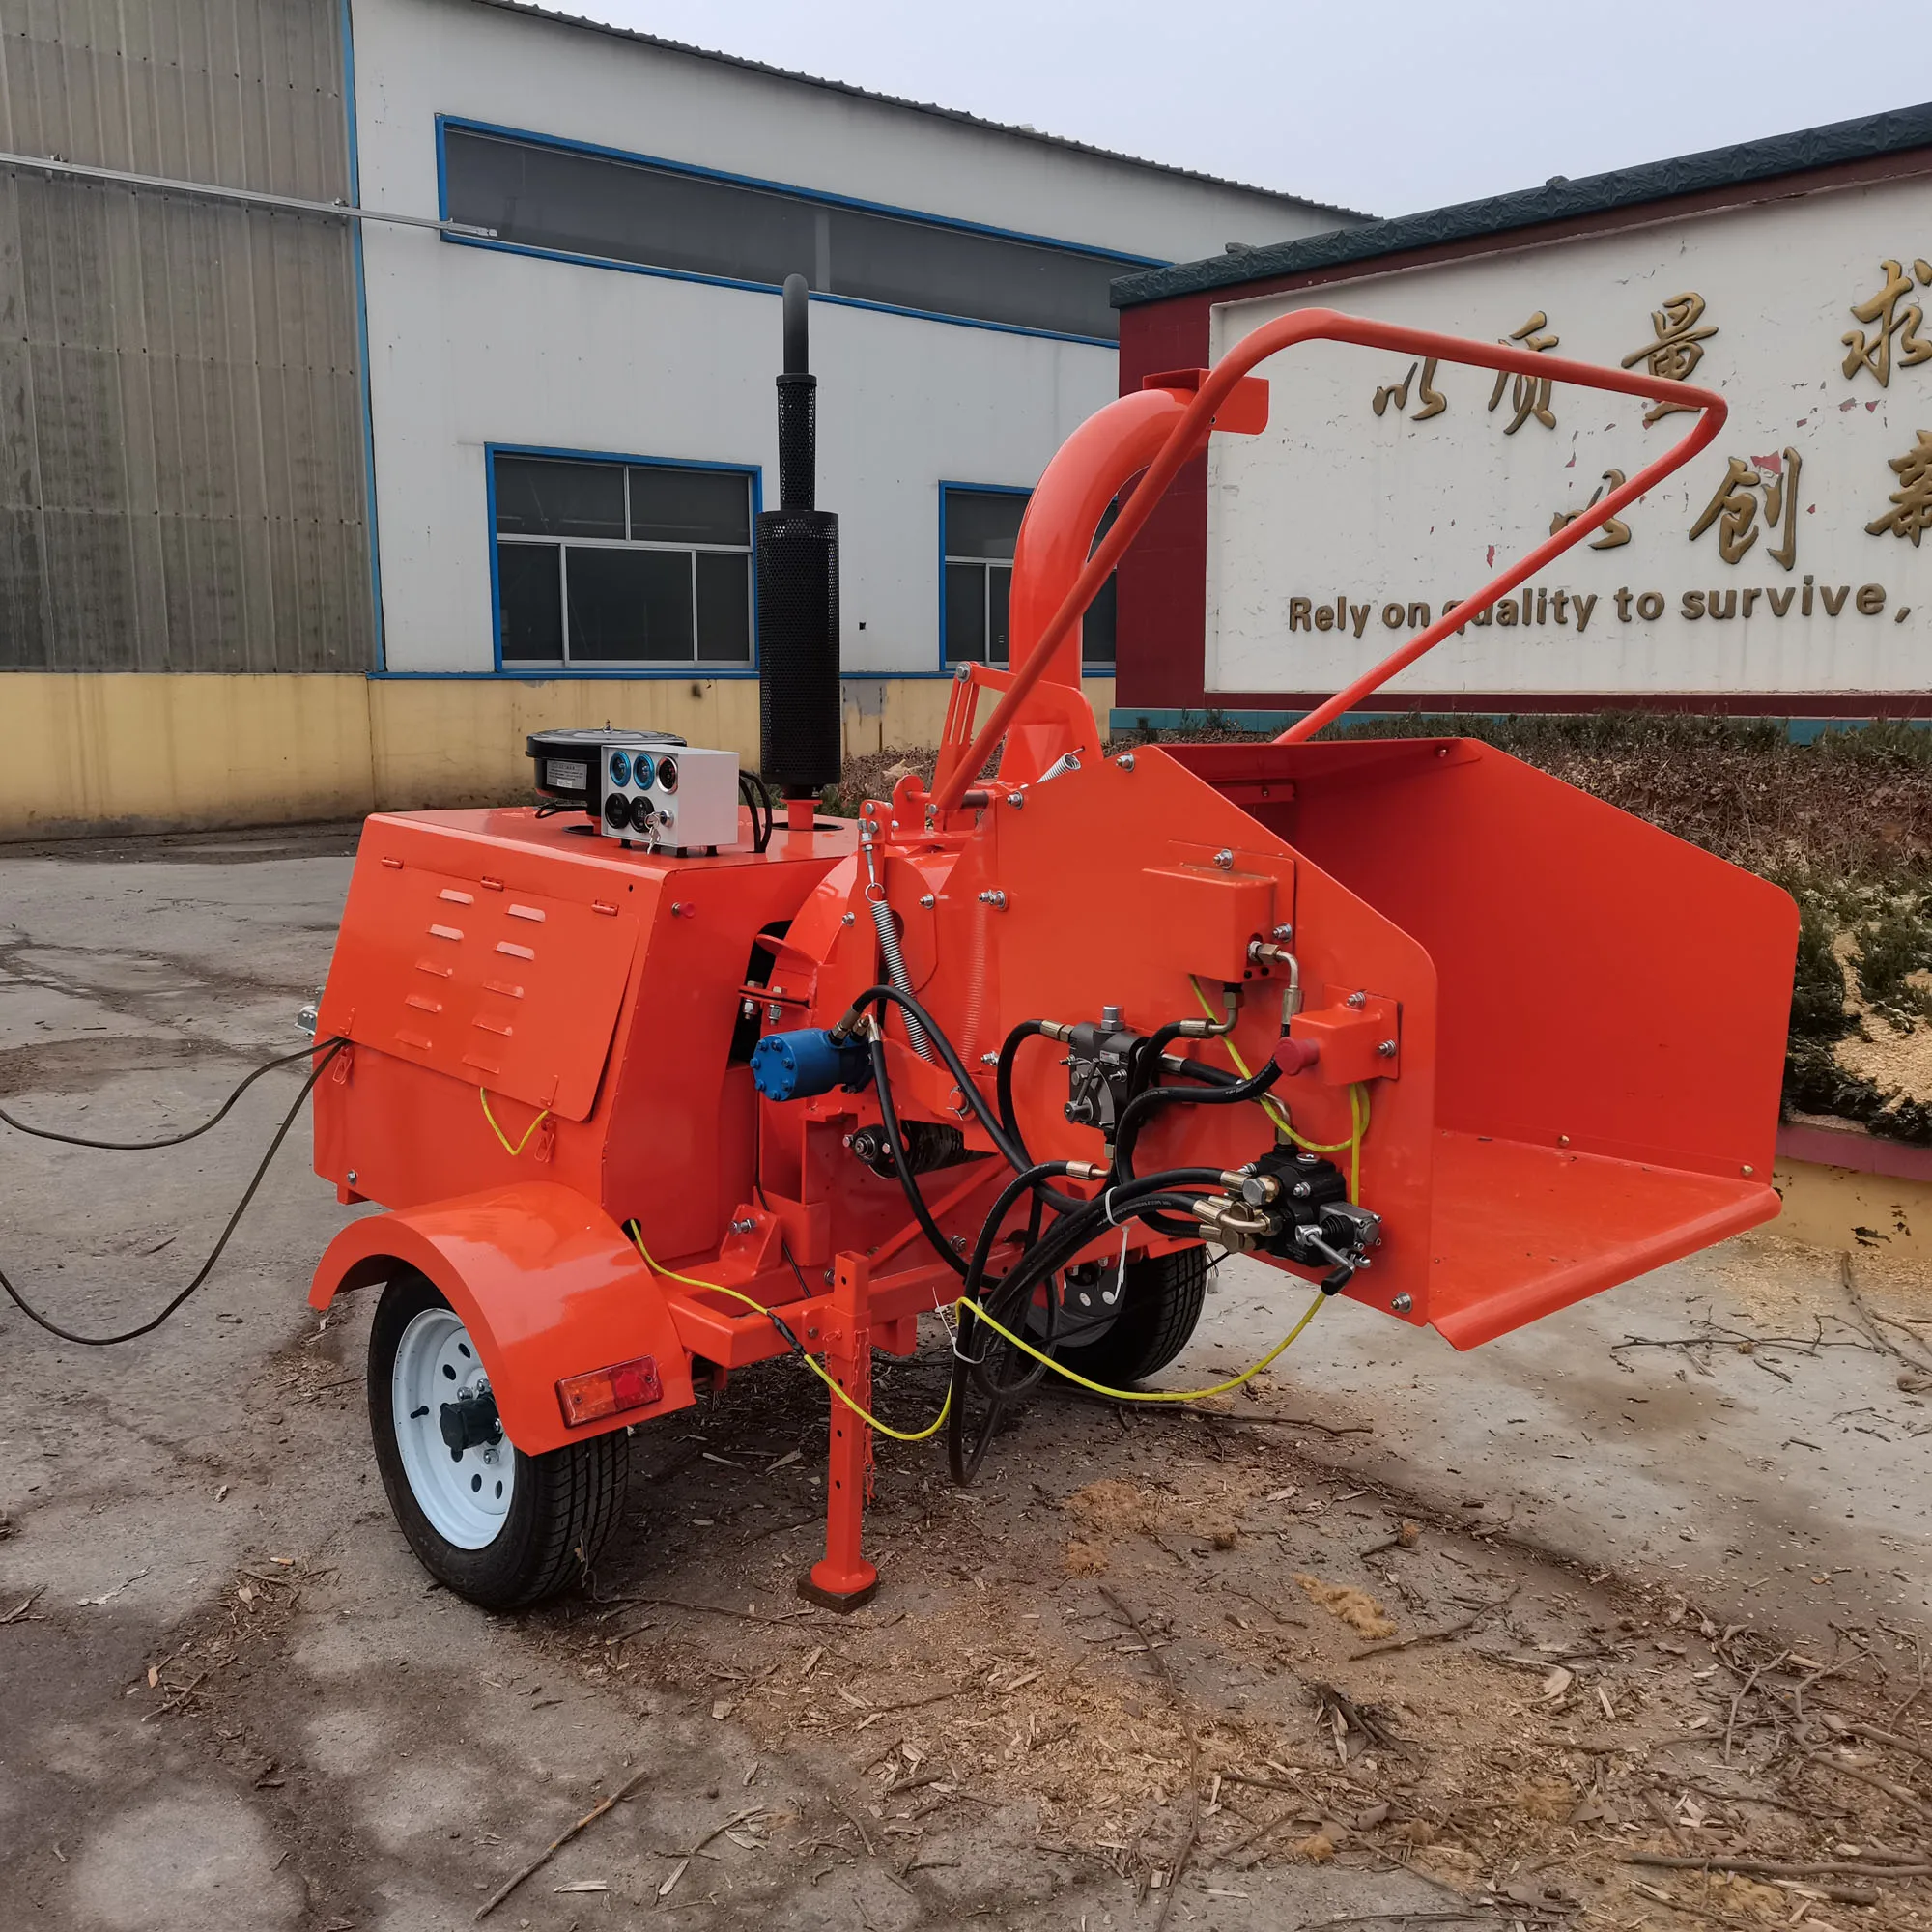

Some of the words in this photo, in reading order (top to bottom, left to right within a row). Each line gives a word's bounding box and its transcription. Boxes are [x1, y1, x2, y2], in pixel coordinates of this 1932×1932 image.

[1289, 595, 1371, 639] Rely
[1381, 600, 1431, 629] on
[1613, 586, 1665, 622] to
[1680, 574, 1912, 623] survive,
